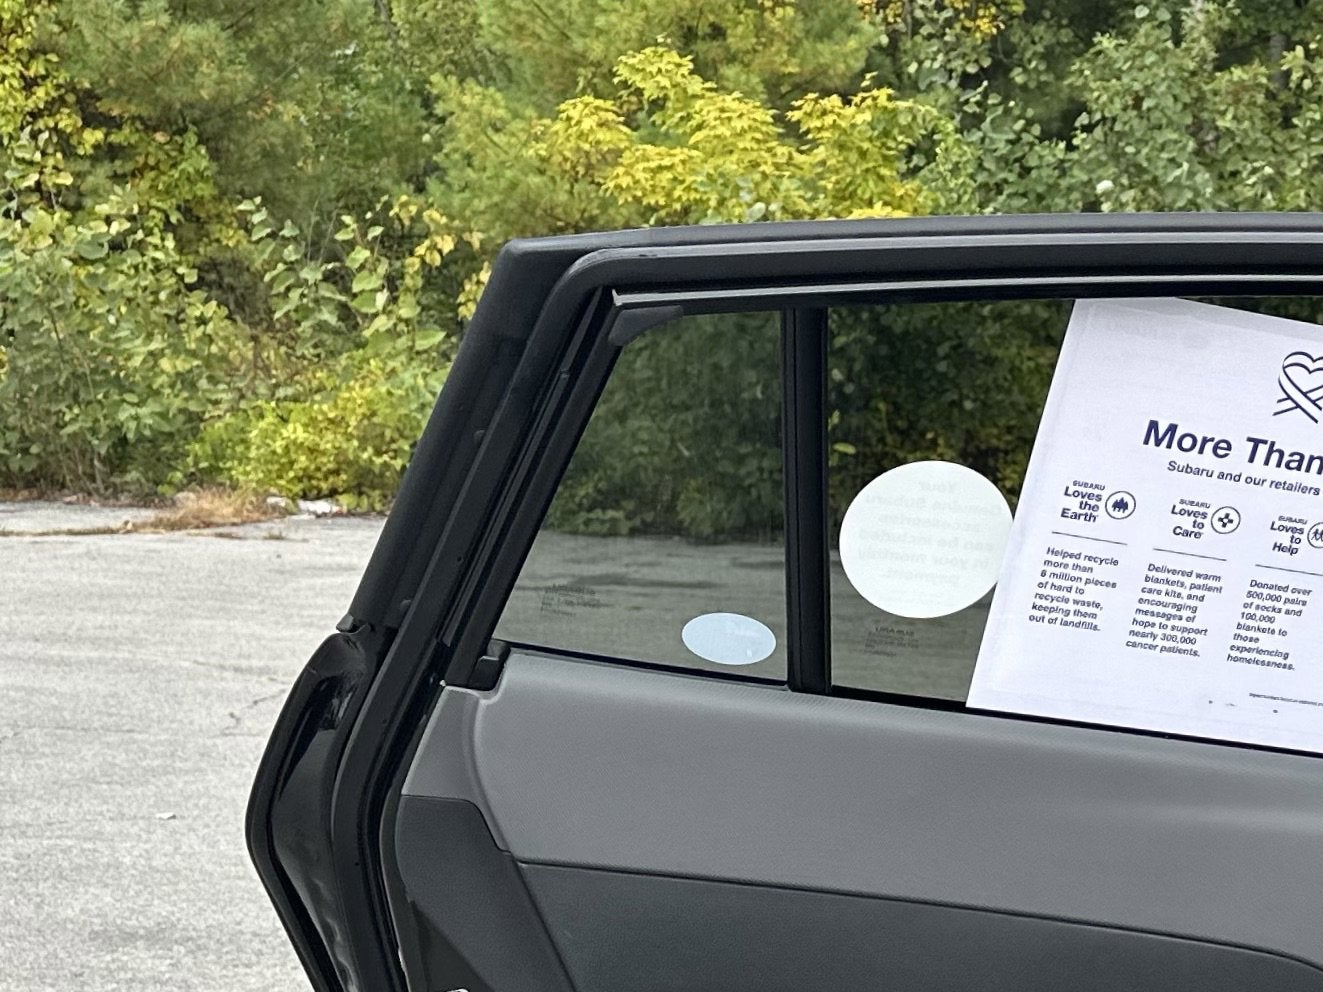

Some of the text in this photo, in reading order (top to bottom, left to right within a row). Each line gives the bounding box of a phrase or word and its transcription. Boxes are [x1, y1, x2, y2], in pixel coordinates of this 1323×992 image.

[1143, 420, 1232, 458] More
[1167, 460, 1214, 477] Subaru
[1217, 471, 1242, 482] and
[1244, 476, 1267, 486] our
[1269, 480, 1320, 495] retailers
[1064, 486, 1102, 502] Loves
[1079, 500, 1099, 512] the
[1171, 504, 1207, 519] Loves
[1192, 519, 1204, 529] to
[1270, 521, 1304, 534] Loves
[1290, 534, 1301, 544] to
[1046, 546, 1118, 566] Helped recycle
[1043, 560, 1093, 573] more than
[1147, 563, 1221, 582] Delivered warm
[1037, 581, 1084, 595] of hard to
[1084, 577, 1116, 588] pieces
[1144, 574, 1222, 593] blankets, patient
[1249, 579, 1312, 596] Donated over
[1034, 592, 1103, 610] recycle waste,
[1141, 587, 1162, 595] care
[1186, 594, 1205, 602] and
[1031, 601, 1097, 619] keeping them
[1138, 597, 1197, 614] encouraging
[1243, 601, 1254, 609] of
[1284, 608, 1302, 616] and
[1028, 614, 1045, 623] out
[1059, 618, 1100, 631] landfills.
[1132, 617, 1208, 636] hope to support
[1185, 615, 1196, 623] of
[1129, 630, 1158, 641] nearly
[1278, 628, 1287, 636] to
[1125, 640, 1200, 657] cancer patients.
